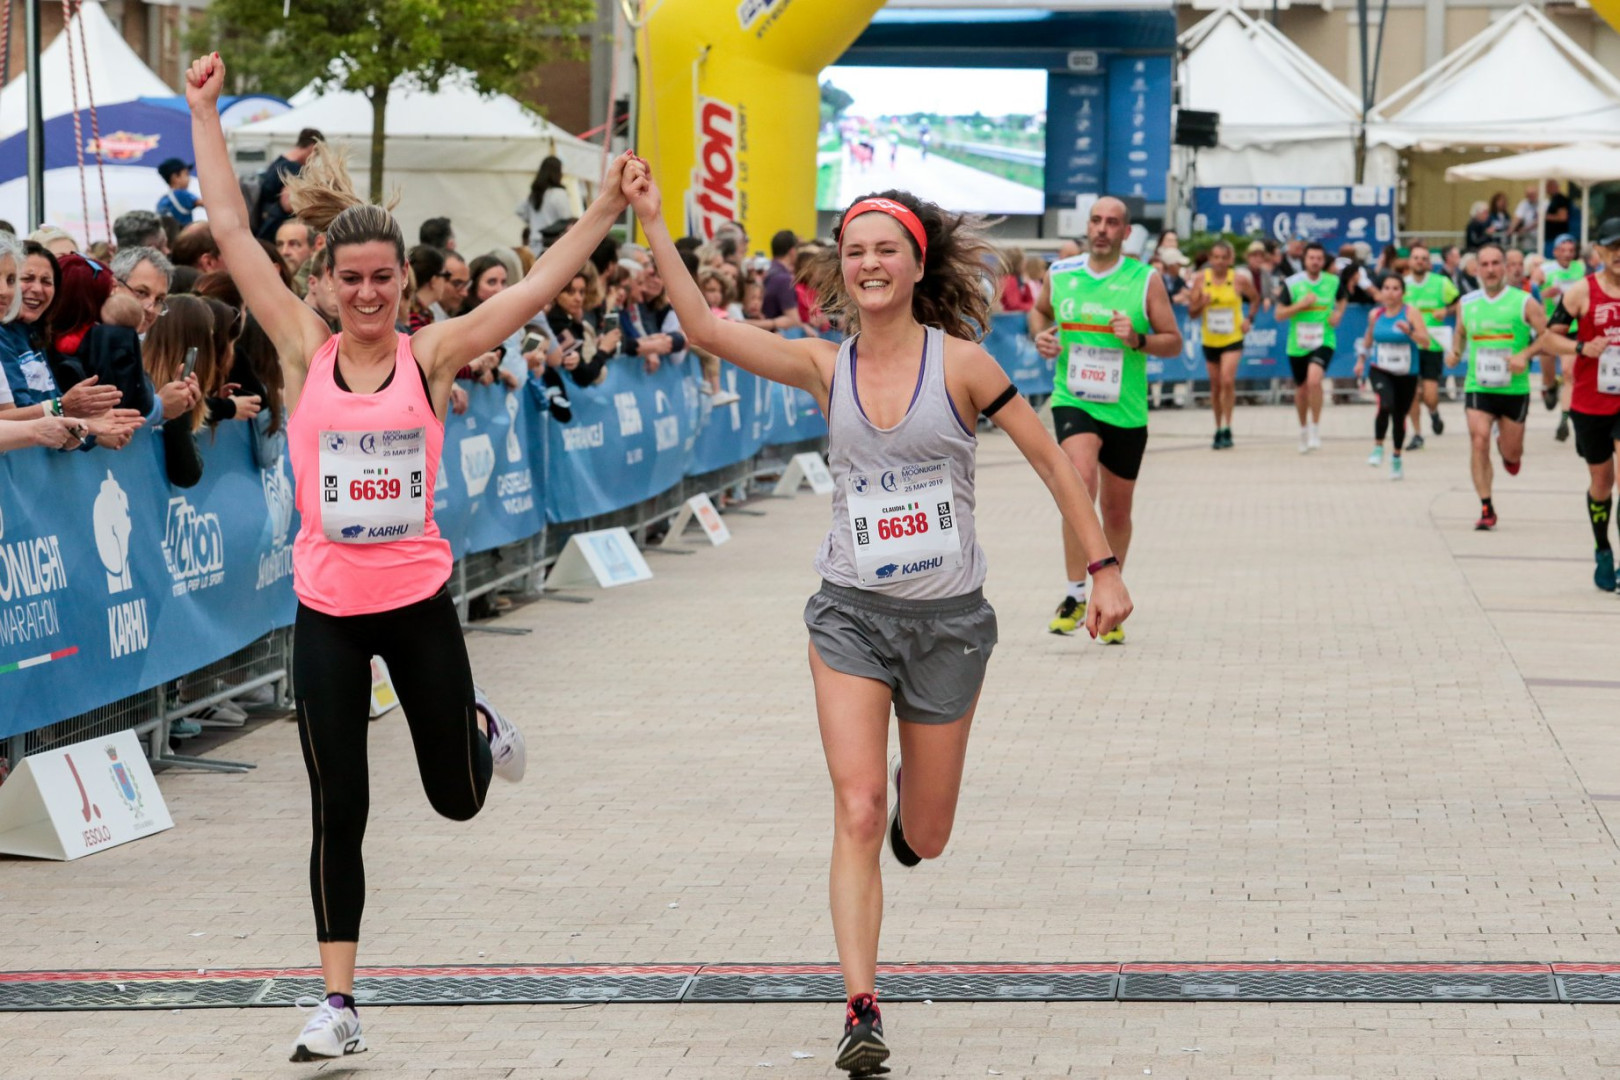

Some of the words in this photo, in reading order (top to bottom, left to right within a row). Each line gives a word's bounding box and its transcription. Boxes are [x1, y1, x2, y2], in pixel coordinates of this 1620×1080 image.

[1081, 369, 1106, 381] 6702
[901, 464, 942, 477] MOONLIGHT
[349, 478, 401, 501] 6639
[904, 485, 913, 493] 25
[928, 479, 944, 487] 2019
[882, 505, 906, 513] CLAUDIA
[367, 524, 408, 538] KARHU
[877, 512, 929, 541] 6638
[901, 556, 943, 575] KARHU
[108, 598, 149, 660] KARHU
[82, 825, 111, 848] JESOLO
